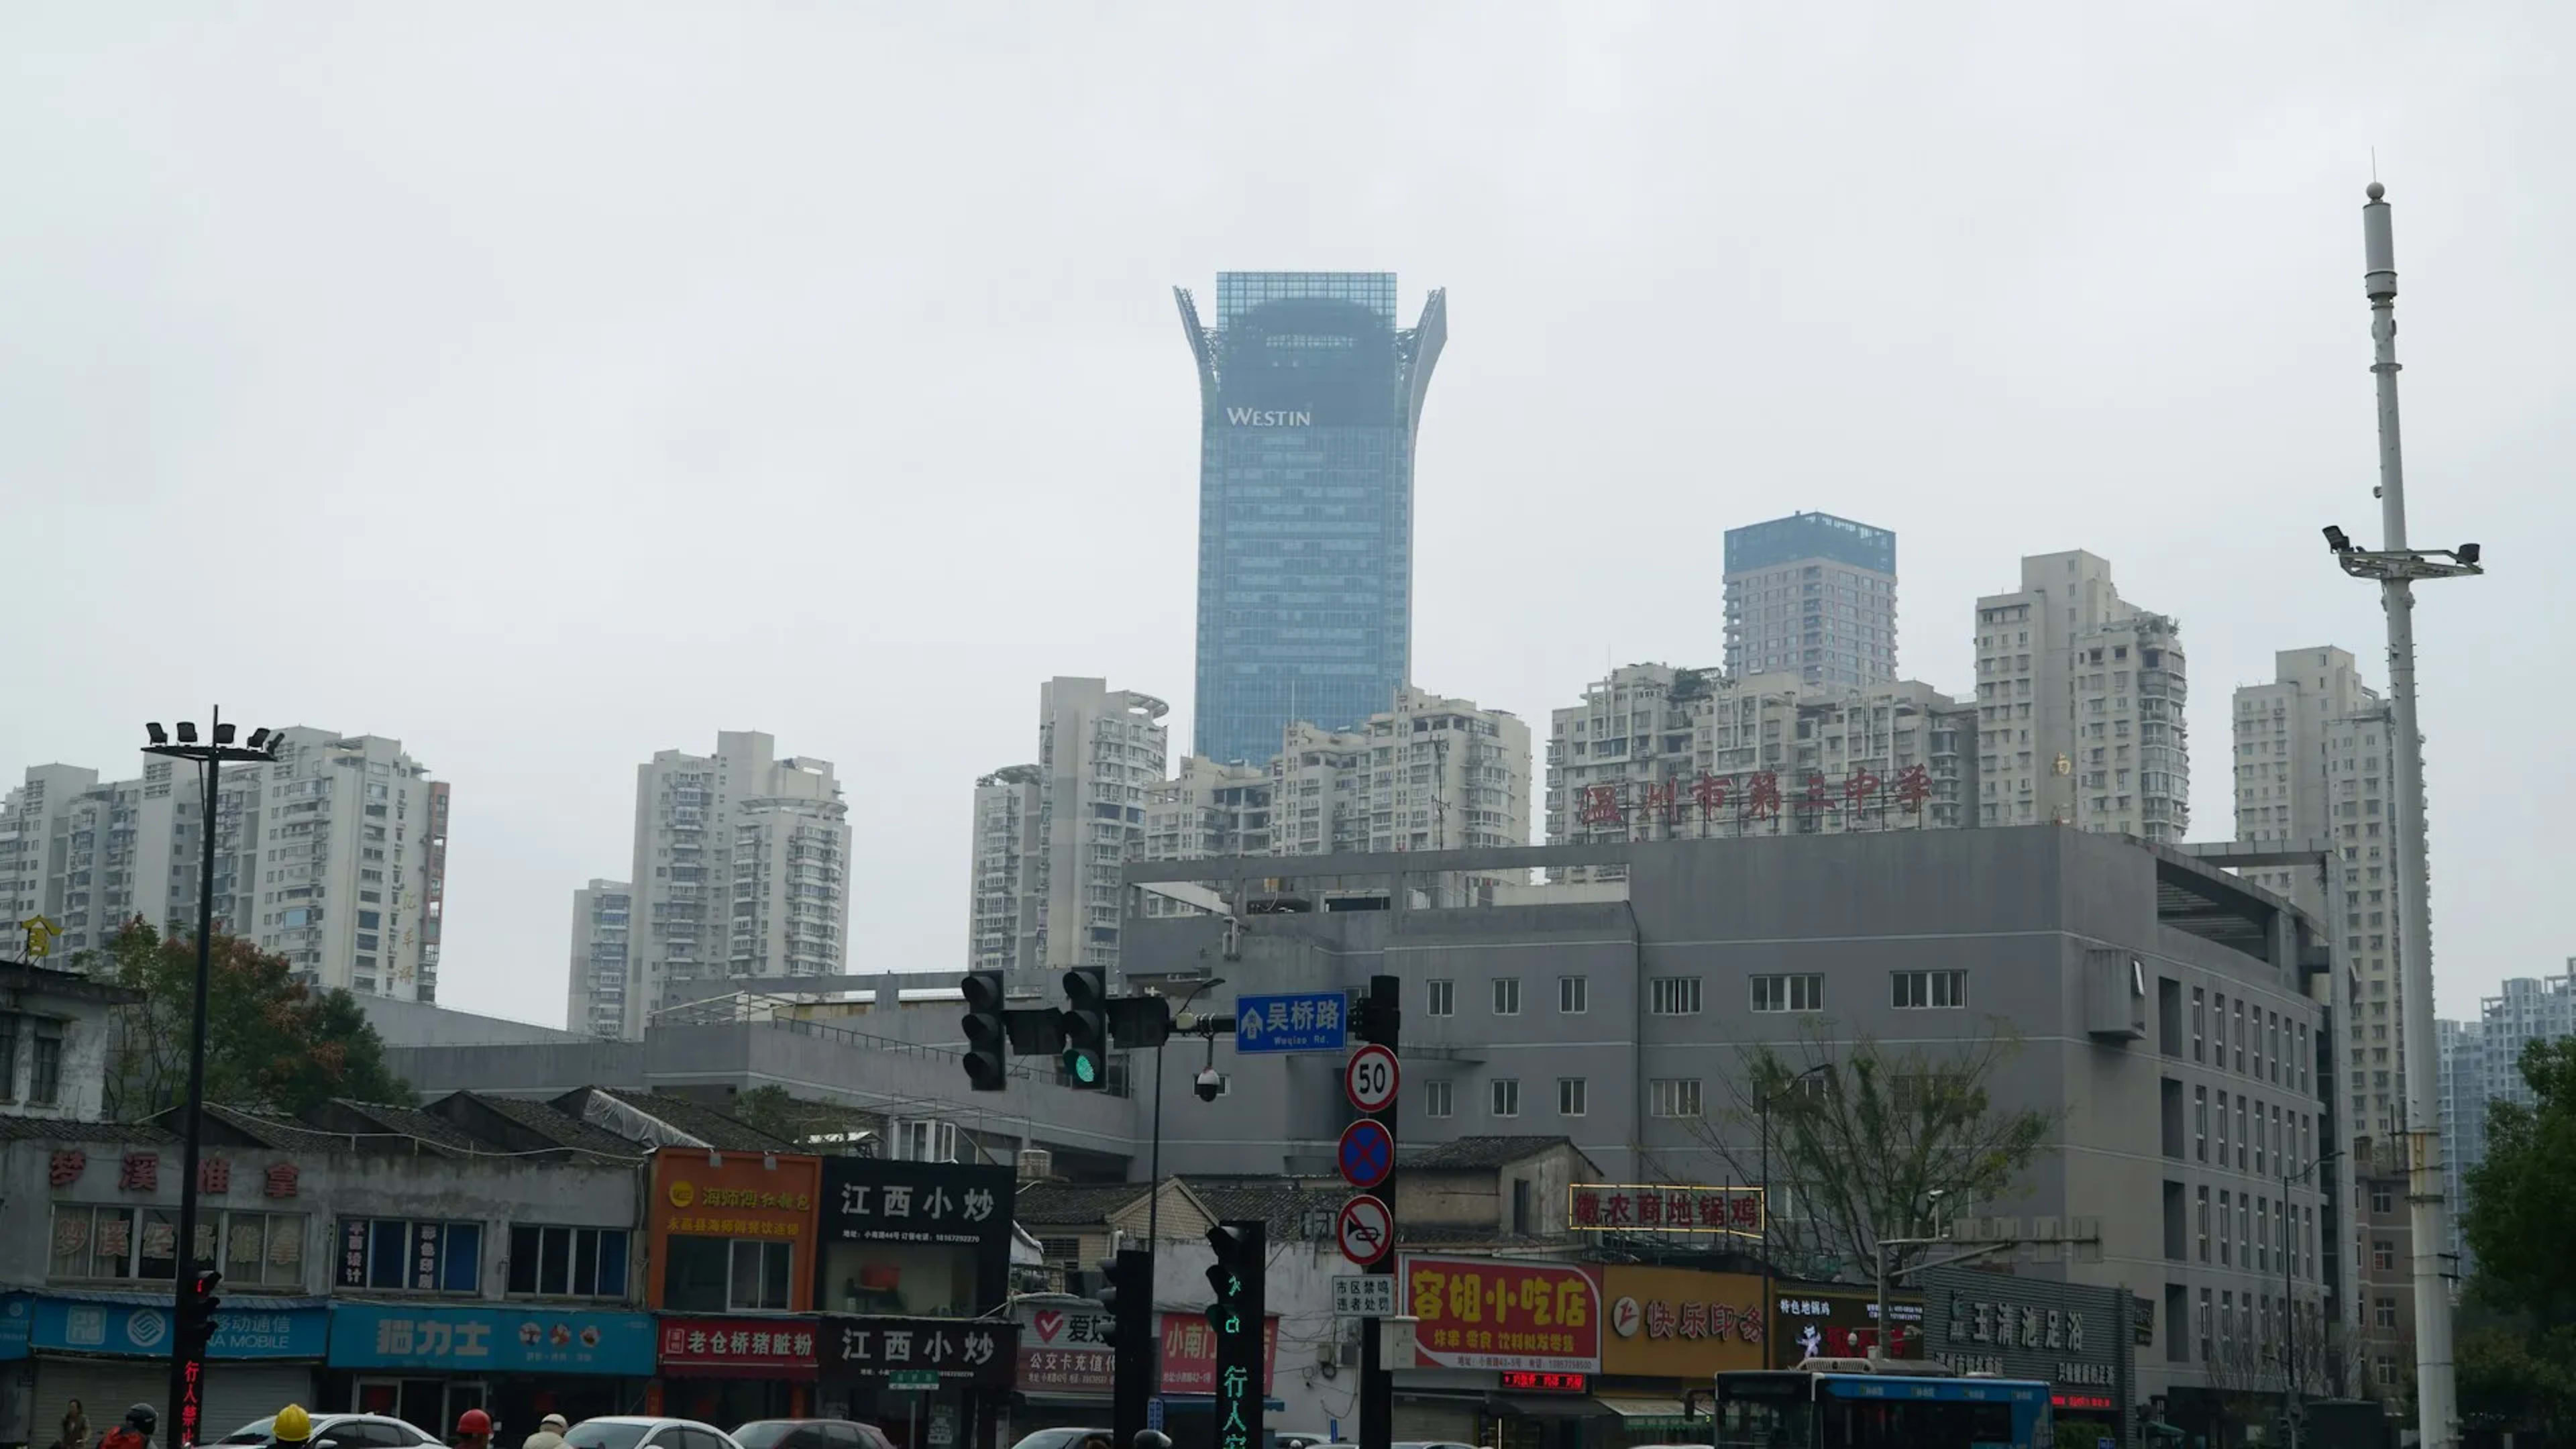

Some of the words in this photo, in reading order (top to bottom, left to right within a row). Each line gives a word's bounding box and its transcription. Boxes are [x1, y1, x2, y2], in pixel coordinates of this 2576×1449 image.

[1226, 407, 1311, 427] WESTIN
[1267, 1000, 1340, 1031] 吴桥路
[1359, 1064, 1386, 1094] 50
[841, 1183, 994, 1222] 江西小炒
[345, 1220, 365, 1283] 平面设计
[1336, 1281, 1389, 1294] 市区禁鸣
[1412, 1269, 1587, 1327] 容姐小吃店
[1337, 1297, 1389, 1311] 违者处罚
[1779, 1298, 1831, 1316] 特色地锅鸡
[207, 1313, 290, 1334] 移动通信
[1646, 1300, 1763, 1342] 快乐印务
[1972, 1301, 2083, 1352] 玉清池足浴
[231, 1335, 290, 1349] MOBILE
[688, 1330, 812, 1356] 老仓桥猪脏粉
[842, 1326, 995, 1365] 江西小炒
